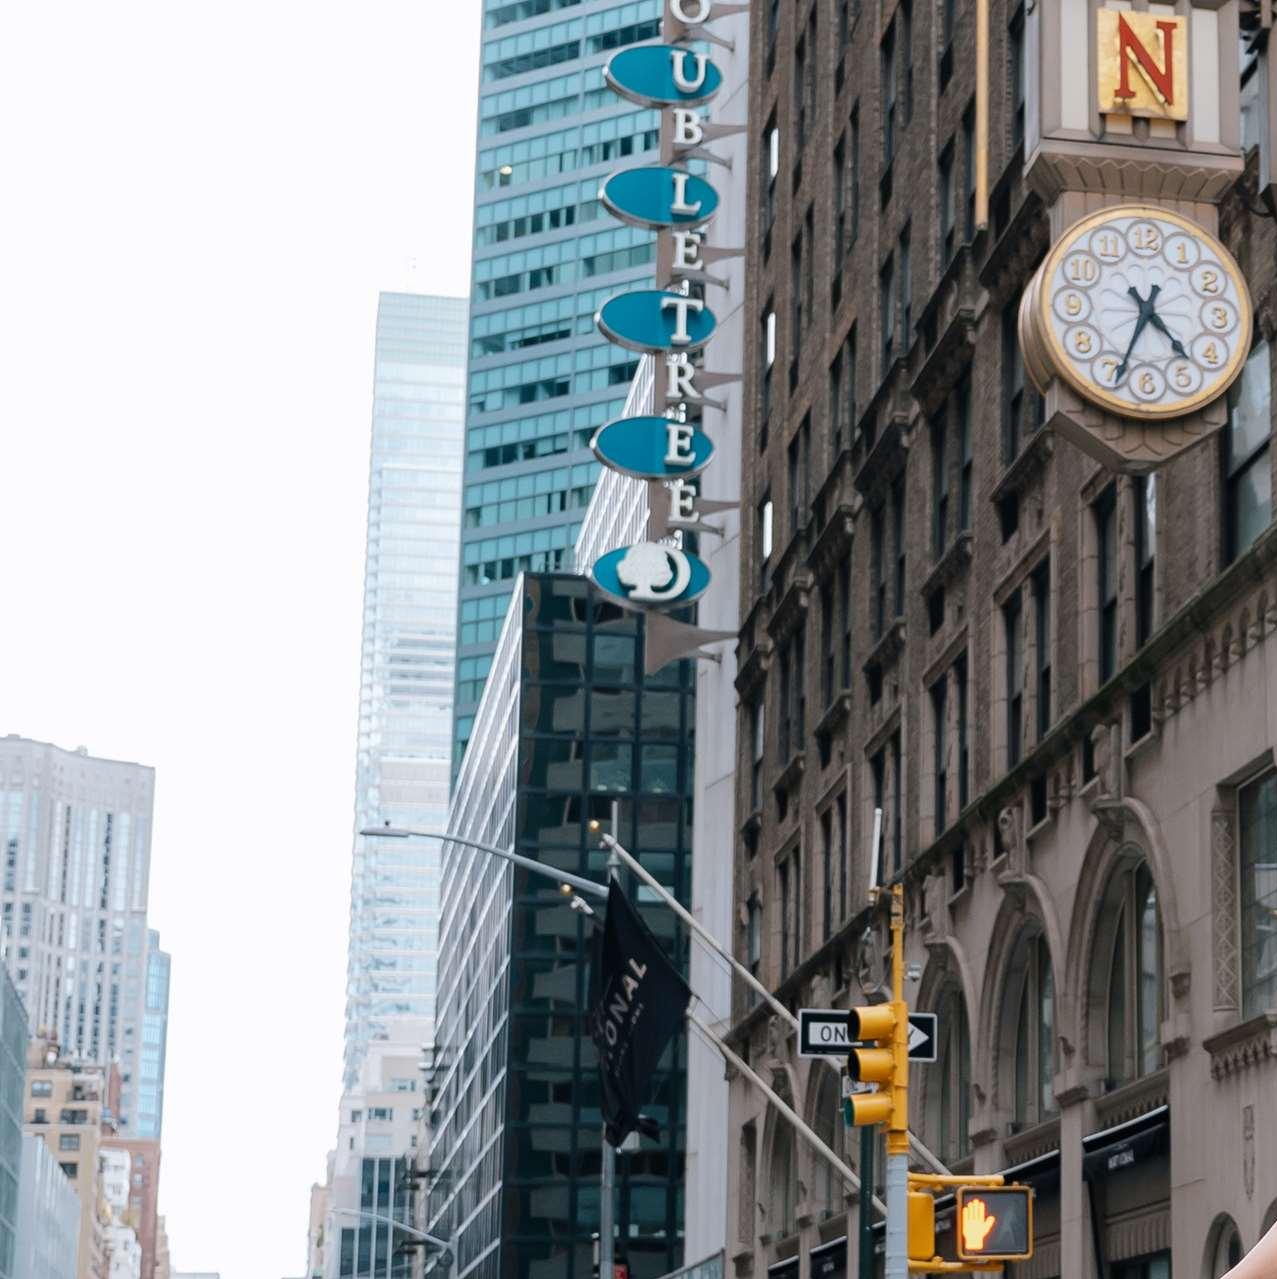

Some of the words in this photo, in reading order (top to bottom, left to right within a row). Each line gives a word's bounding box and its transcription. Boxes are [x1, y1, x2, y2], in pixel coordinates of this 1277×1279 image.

[1099, 235, 1119, 257] 11
[1135, 227, 1159, 251] 12
[1176, 242, 1189, 264] 1
[1071, 259, 1094, 281] 10
[1201, 271, 1217, 293] 2
[1065, 294, 1081, 315] 9
[1212, 307, 1227, 328] 3
[1075, 332, 1091, 353] 8
[1203, 342, 1217, 364] 4
[1102, 361, 1117, 382] 7
[1175, 366, 1191, 387] 5
[1139, 372, 1155, 394] 6
[820, 1025, 847, 1042] ON
